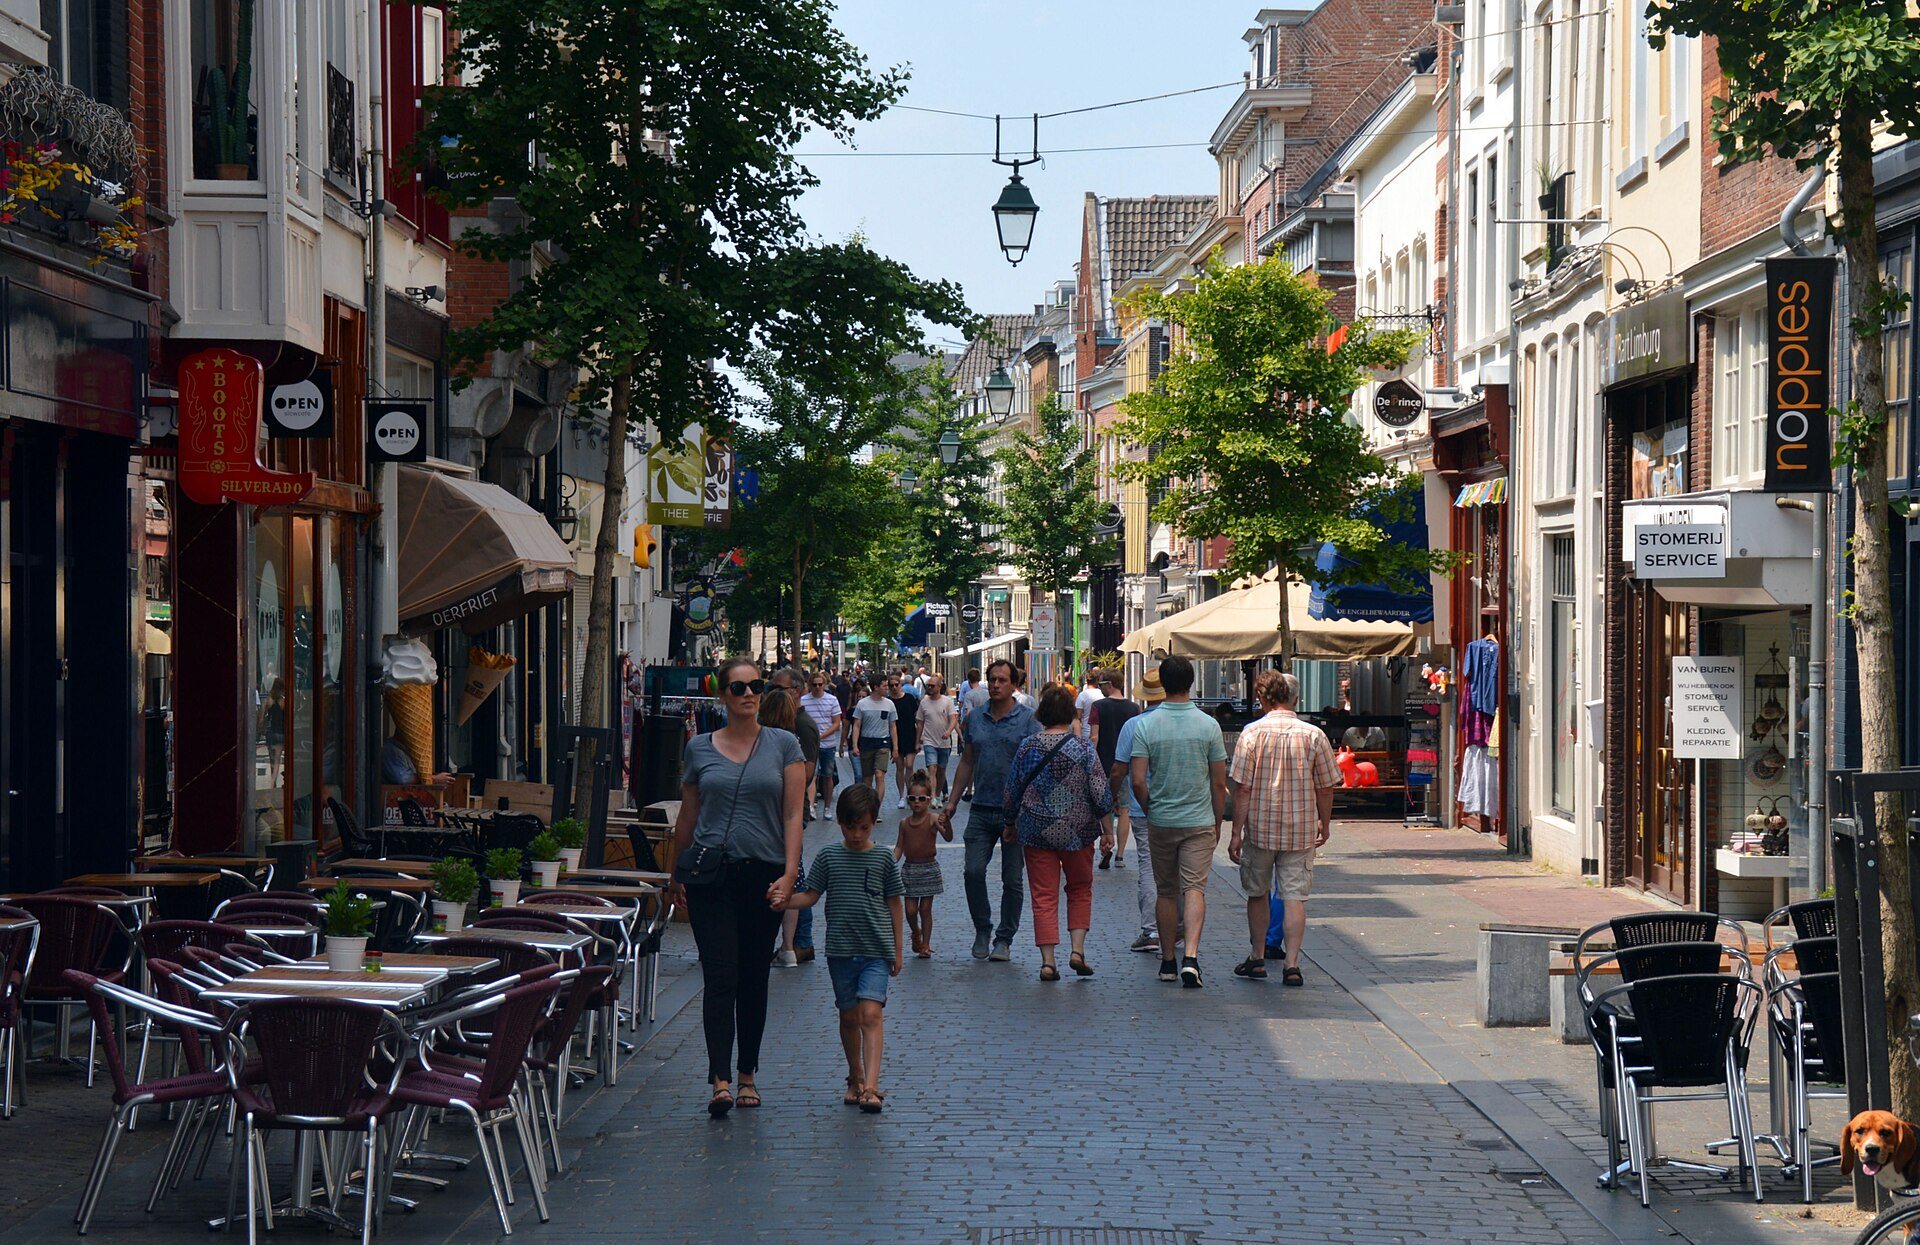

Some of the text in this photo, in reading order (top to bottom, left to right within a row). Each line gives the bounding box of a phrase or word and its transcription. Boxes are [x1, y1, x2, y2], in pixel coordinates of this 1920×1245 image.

[1630, 322, 1661, 363] Limburg
[1776, 280, 1822, 470] noppies
[274, 397, 319, 410] OPEN
[1377, 394, 1422, 407] De Prince
[212, 372, 227, 456] BOOTS
[1380, 406, 1418, 423] RESTAURANT
[378, 428, 415, 438] OPEN
[221, 479, 303, 494] SILVERADO
[661, 508, 689, 519] THEE
[703, 513, 722, 523] FFIE
[1638, 532, 1723, 545] STOMERIJ
[1645, 553, 1718, 567] SERVICE
[432, 587, 499, 627] OERFRIET
[925, 602, 950, 610] Picture
[1700, 666, 1735, 674] BUREN
[1684, 693, 1728, 701] STOMERIJ
[1682, 739, 1731, 747] REPARATIE
